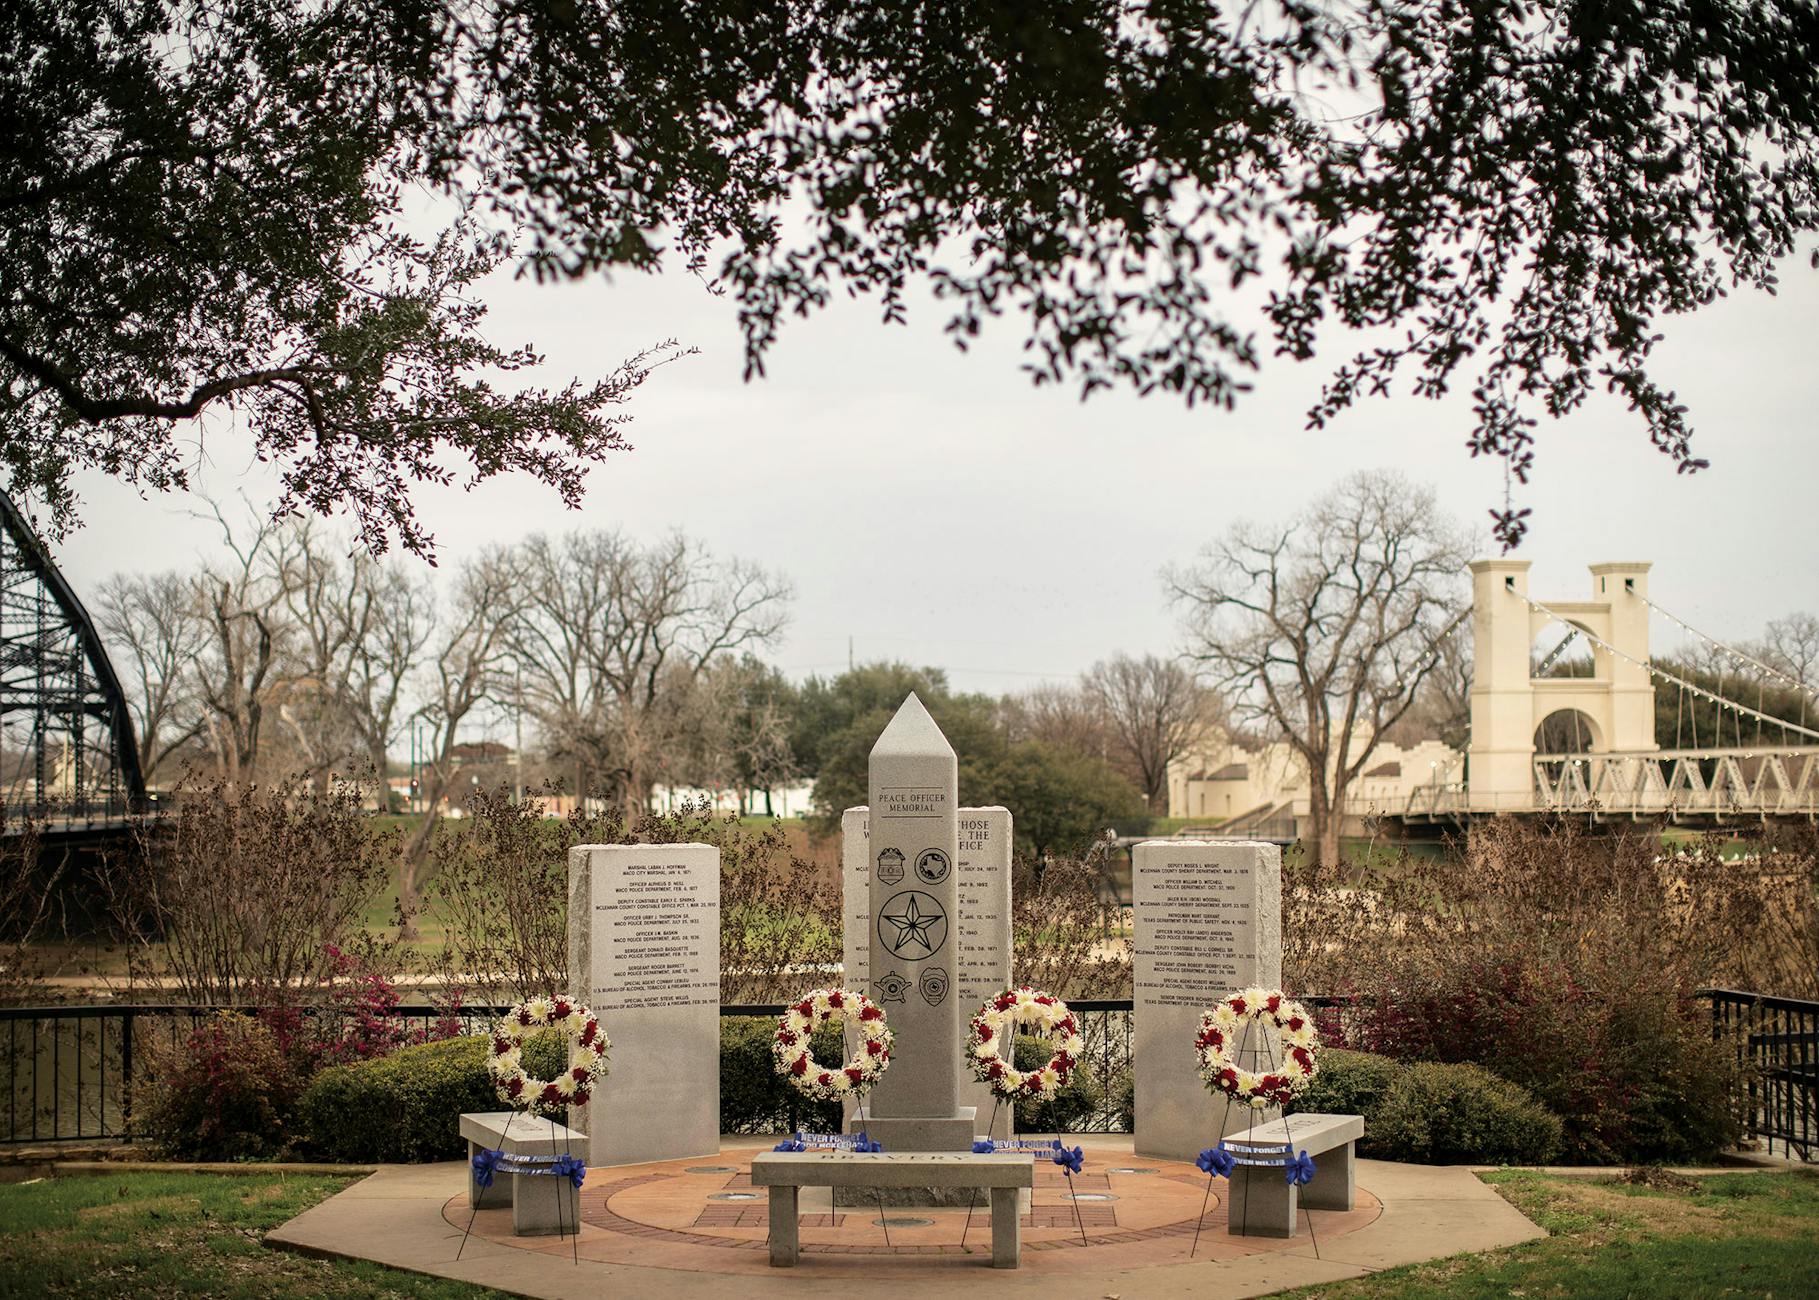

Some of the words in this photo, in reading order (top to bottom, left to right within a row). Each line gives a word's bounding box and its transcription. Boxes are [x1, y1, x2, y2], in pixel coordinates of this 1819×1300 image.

[968, 831, 990, 840] THE
[960, 841, 983, 850] FICE
[801, 1132, 829, 1142] NEVER
[830, 1133, 860, 1143] FORGET
[994, 1140, 1020, 1149] NEVER
[1022, 1140, 1054, 1148] FORGET
[1224, 1142, 1252, 1152] NEVER
[1253, 1146, 1286, 1154] FORGET
[502, 1152, 530, 1162] NEVER
